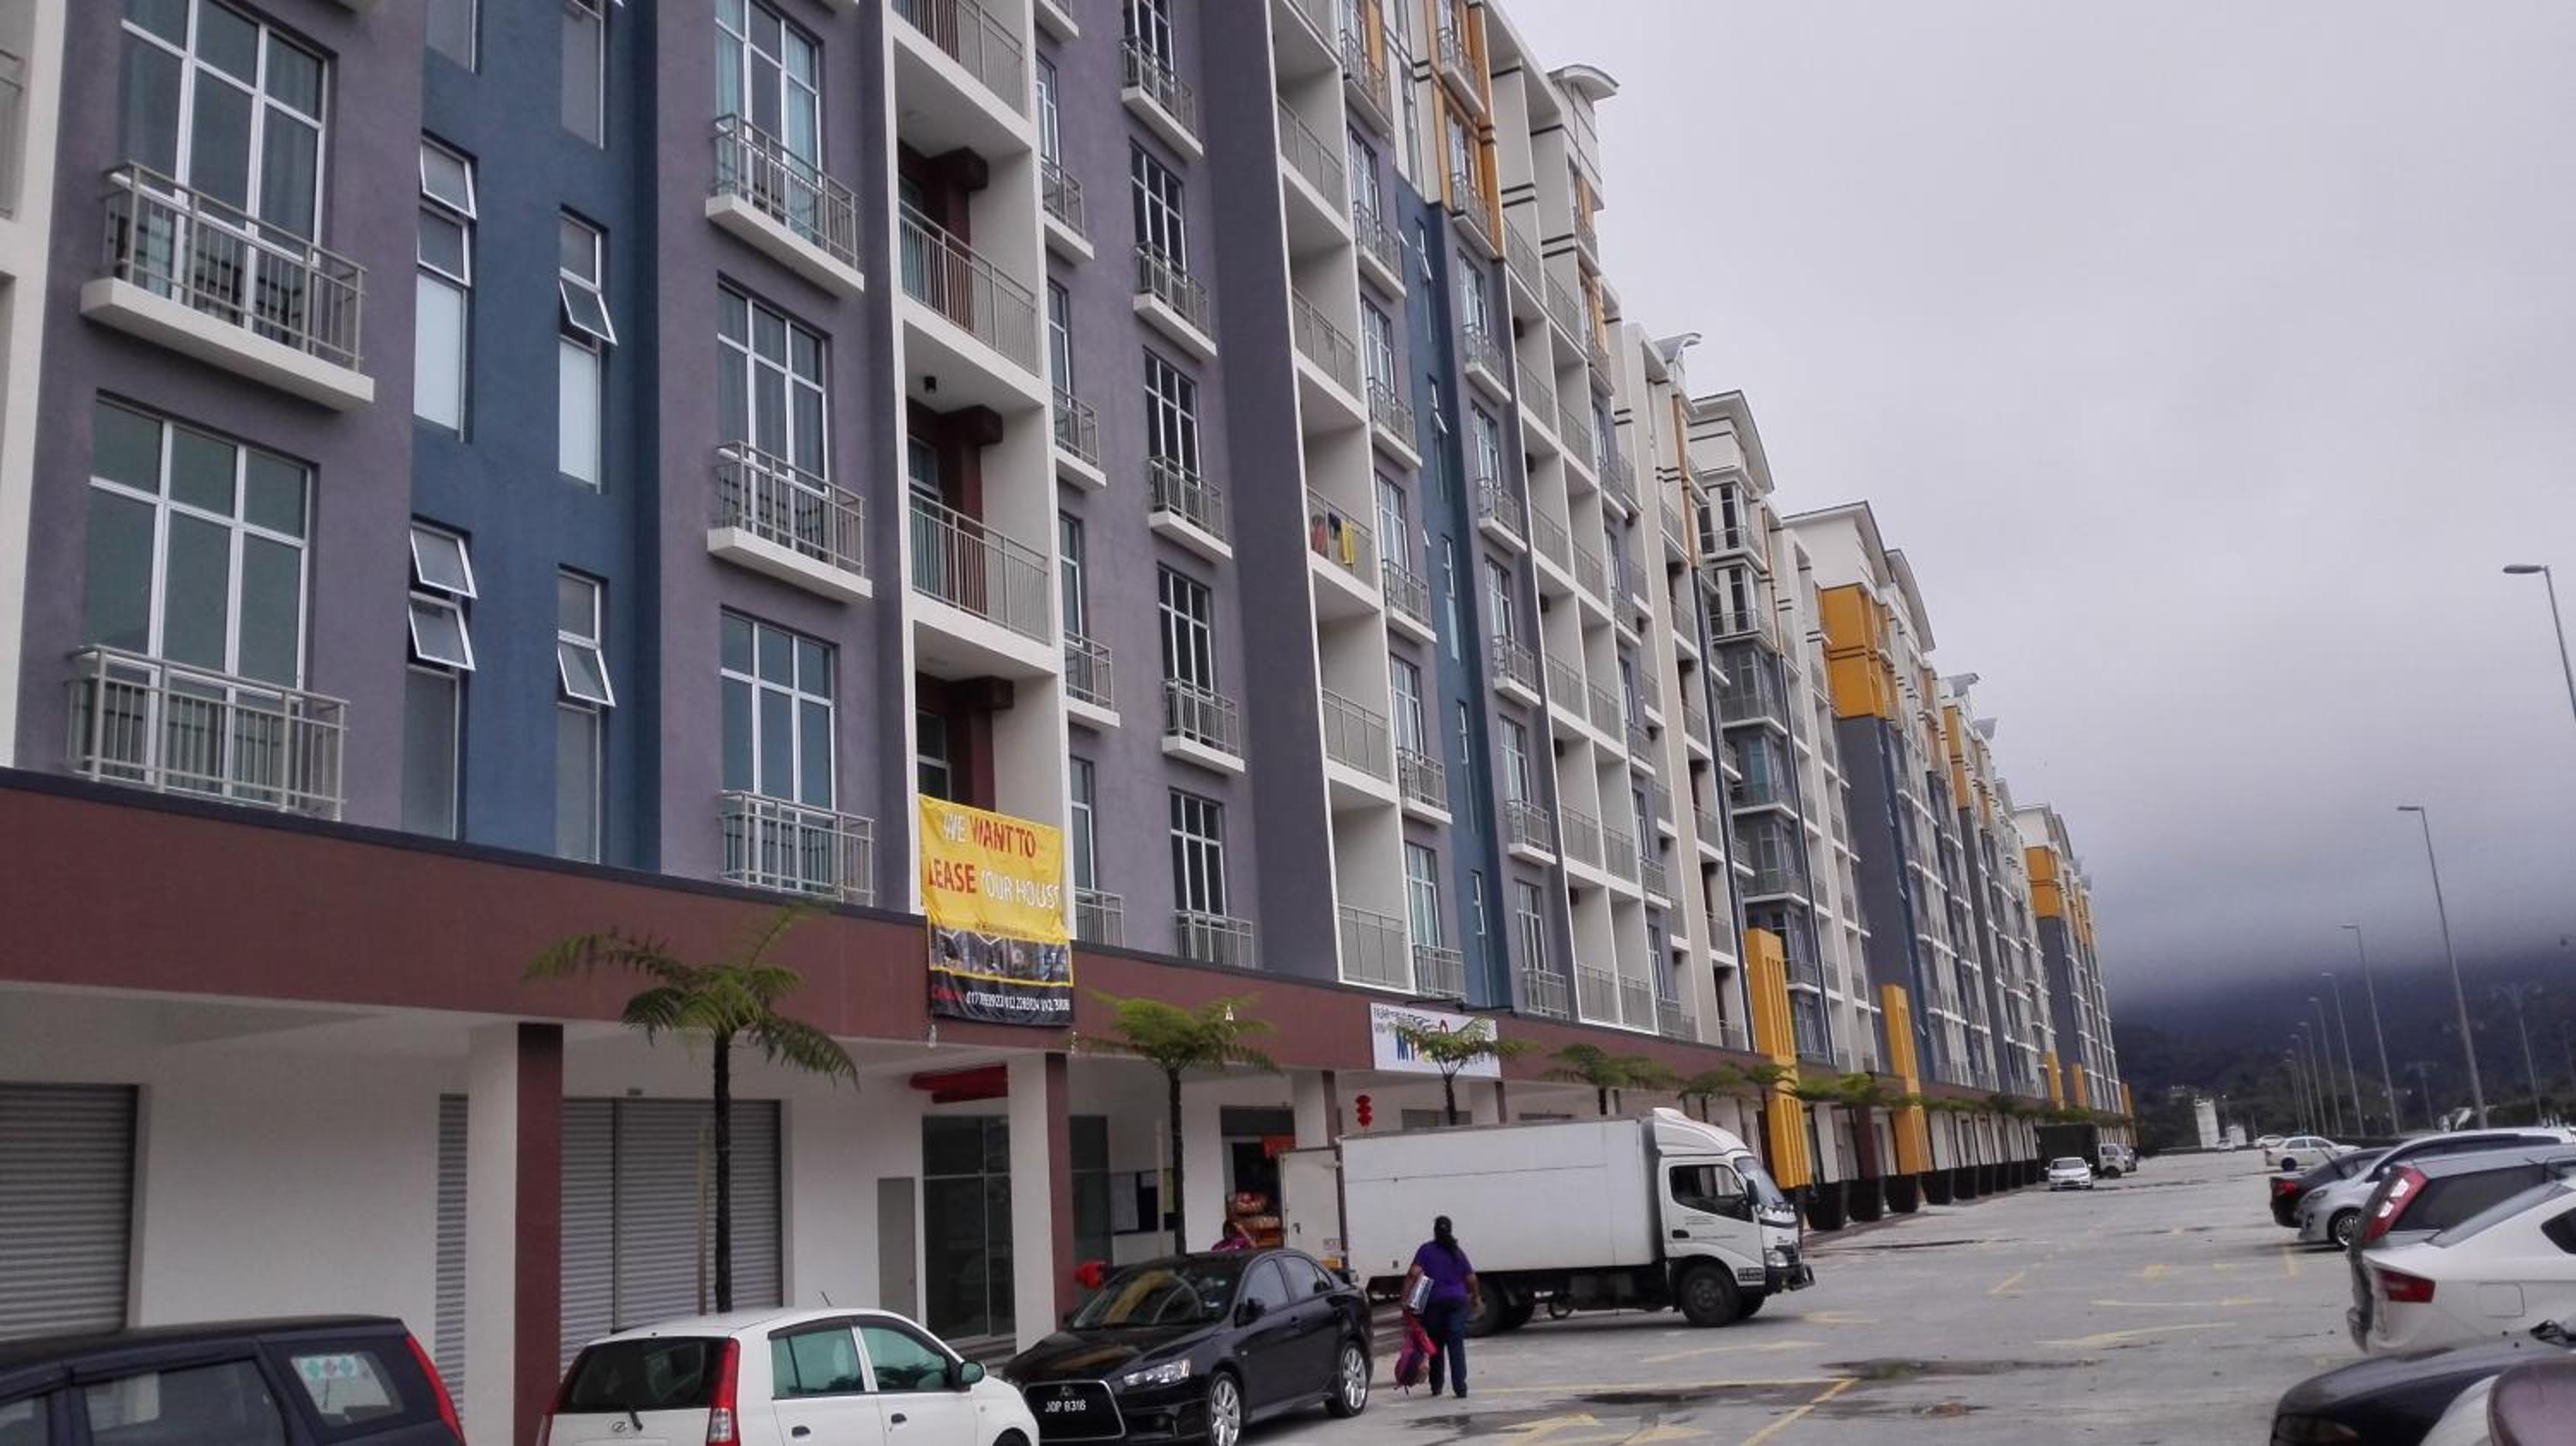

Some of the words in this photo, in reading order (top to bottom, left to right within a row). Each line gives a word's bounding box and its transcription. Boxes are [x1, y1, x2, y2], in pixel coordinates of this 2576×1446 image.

[945, 814, 966, 842] WE
[969, 816, 1012, 853] WANT
[1016, 827, 1036, 859] TO
[928, 858, 977, 894] LEASE
